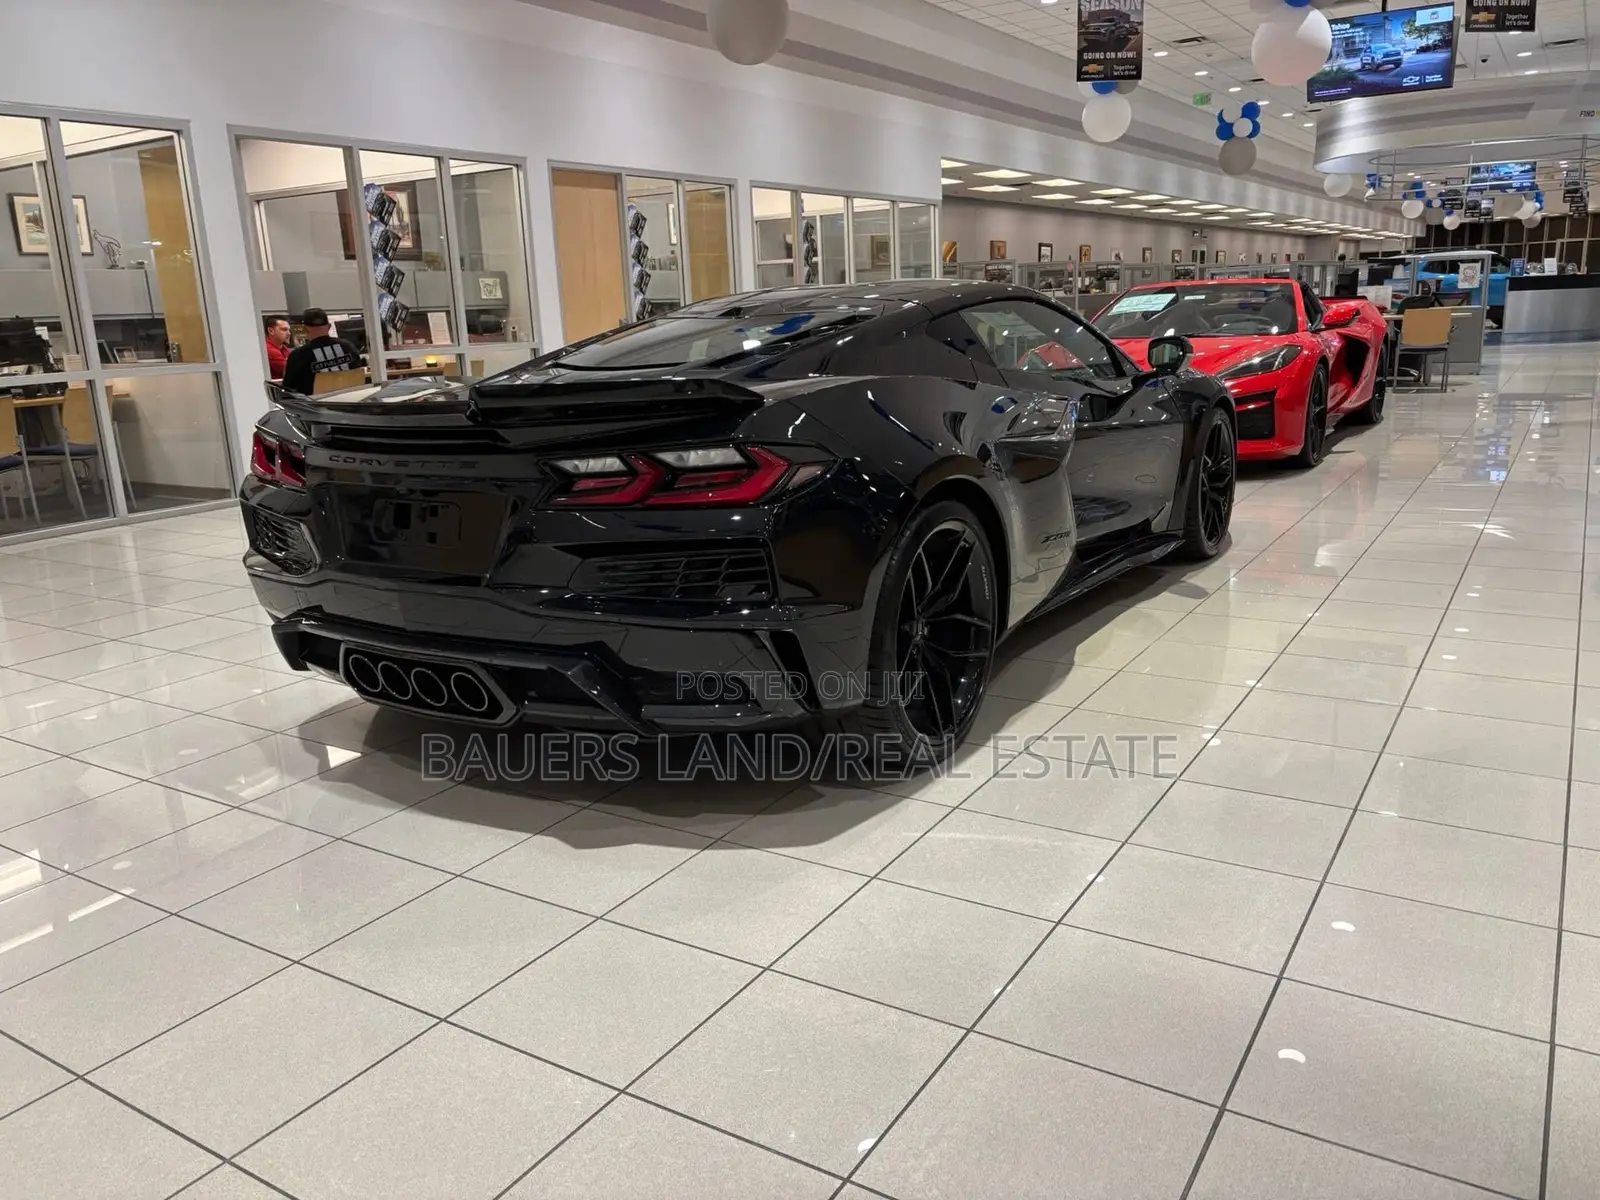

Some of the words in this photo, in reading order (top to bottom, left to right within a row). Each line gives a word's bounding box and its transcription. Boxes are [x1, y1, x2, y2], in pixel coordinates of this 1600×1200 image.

[1080, 0, 1141, 11] SEASON
[1083, 52, 1104, 60] GOING
[1117, 51, 1137, 59] NOW!
[1579, 110, 1595, 118] FIND
[328, 454, 480, 469] CORVETTE
